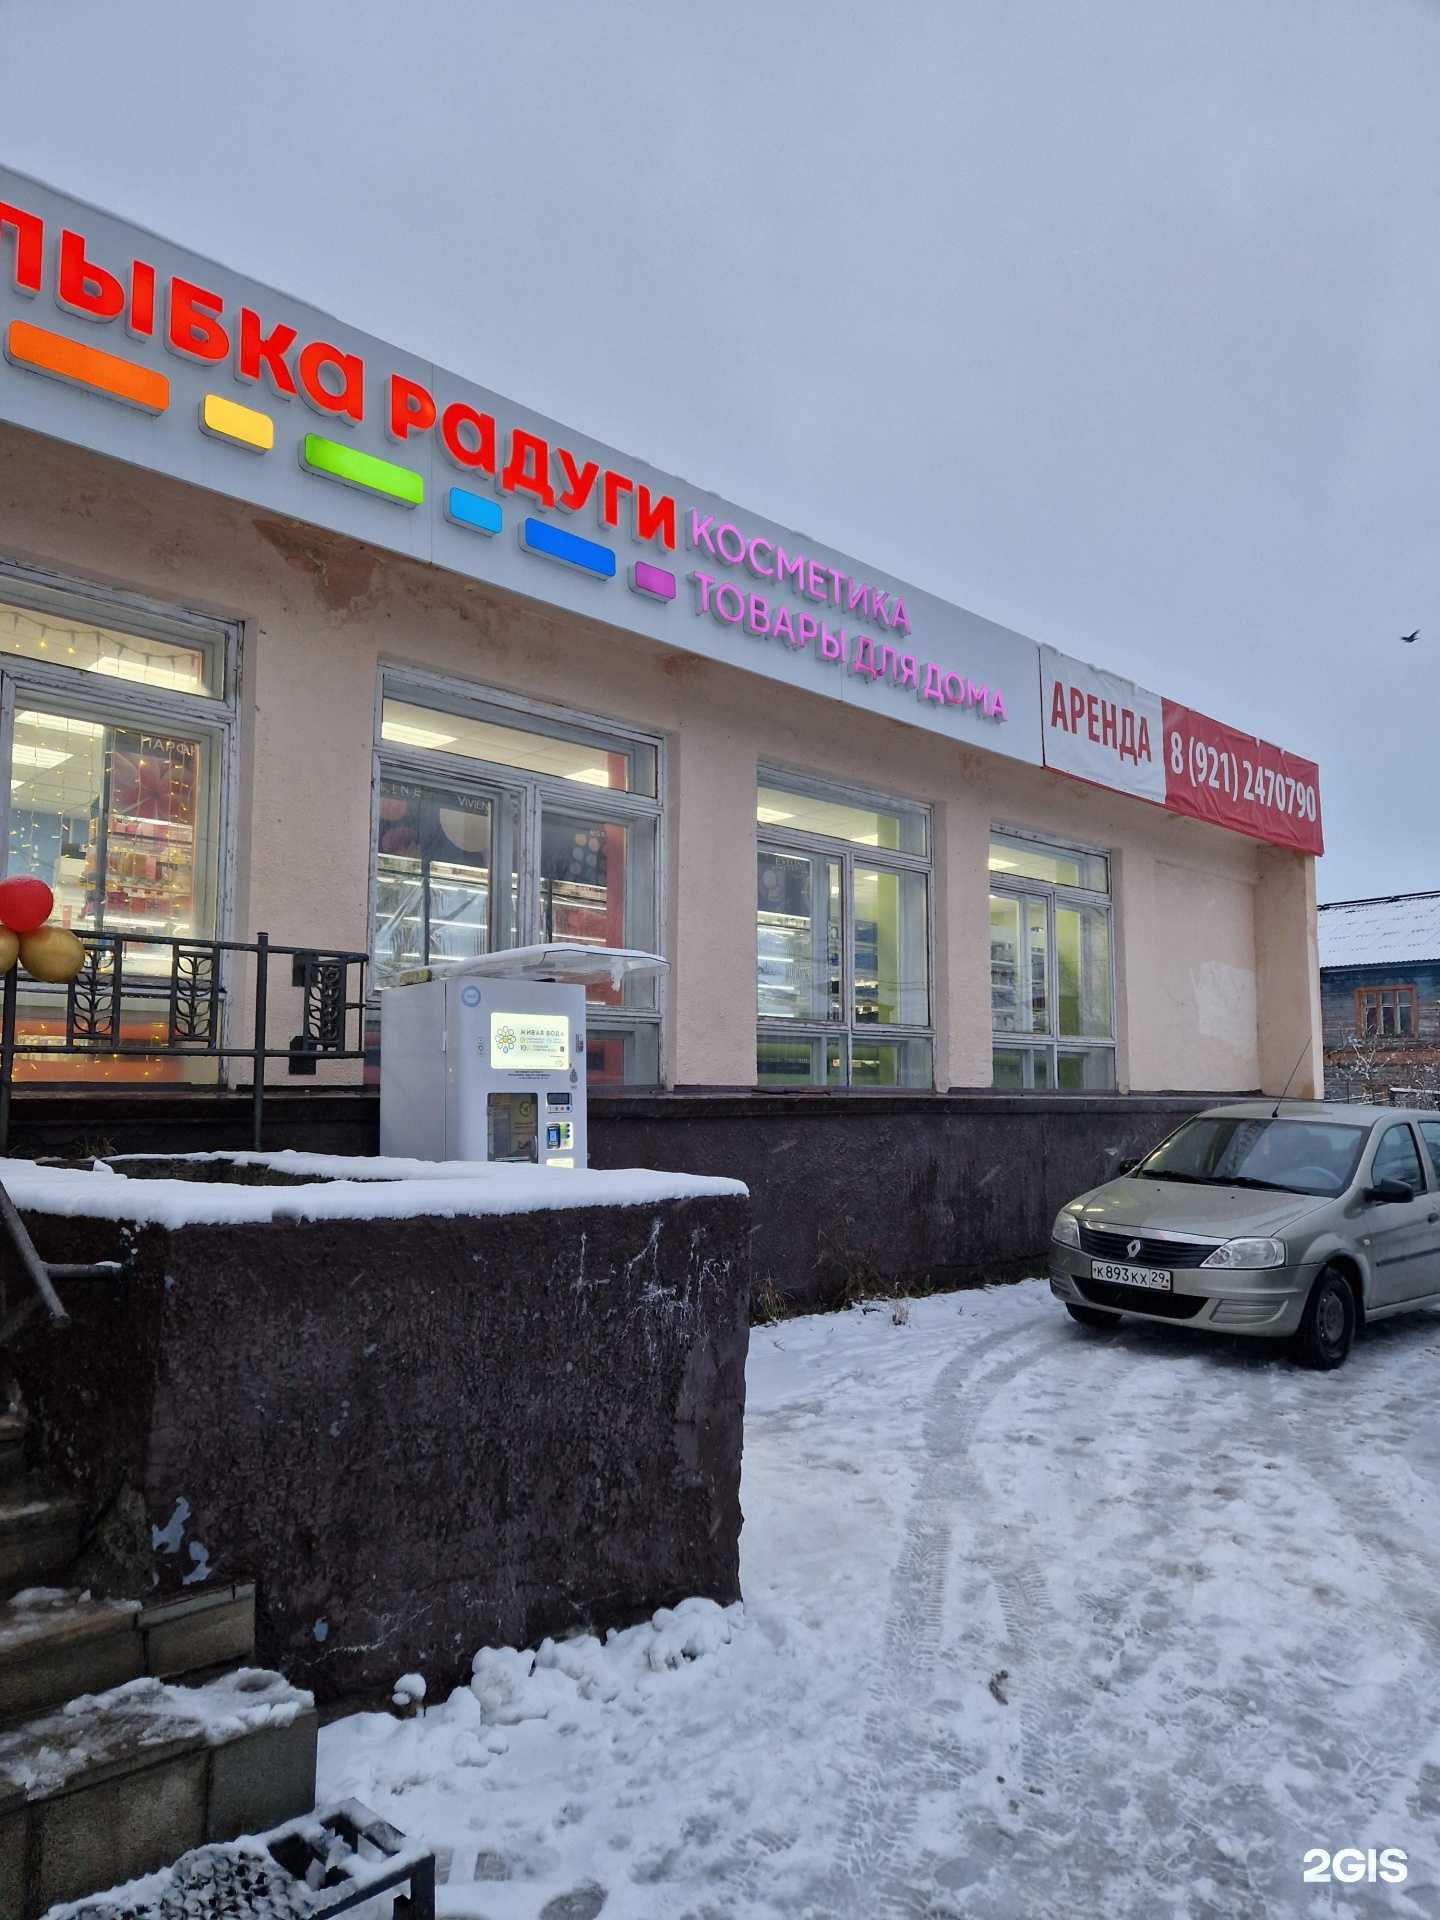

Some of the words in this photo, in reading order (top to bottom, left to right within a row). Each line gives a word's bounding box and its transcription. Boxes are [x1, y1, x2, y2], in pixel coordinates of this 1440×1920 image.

[690, 507, 912, 637] КОСМЕТИКА
[692, 570, 848, 664] ТОВАРЫ
[852, 635, 918, 690] ДЛЯ
[922, 662, 1008, 723] ДОМА
[1051, 680, 1152, 767] АРЕНДА
[1170, 731, 1184, 775] 8
[1188, 736, 1239, 801] (921)
[1243, 760, 1317, 822] 2470790
